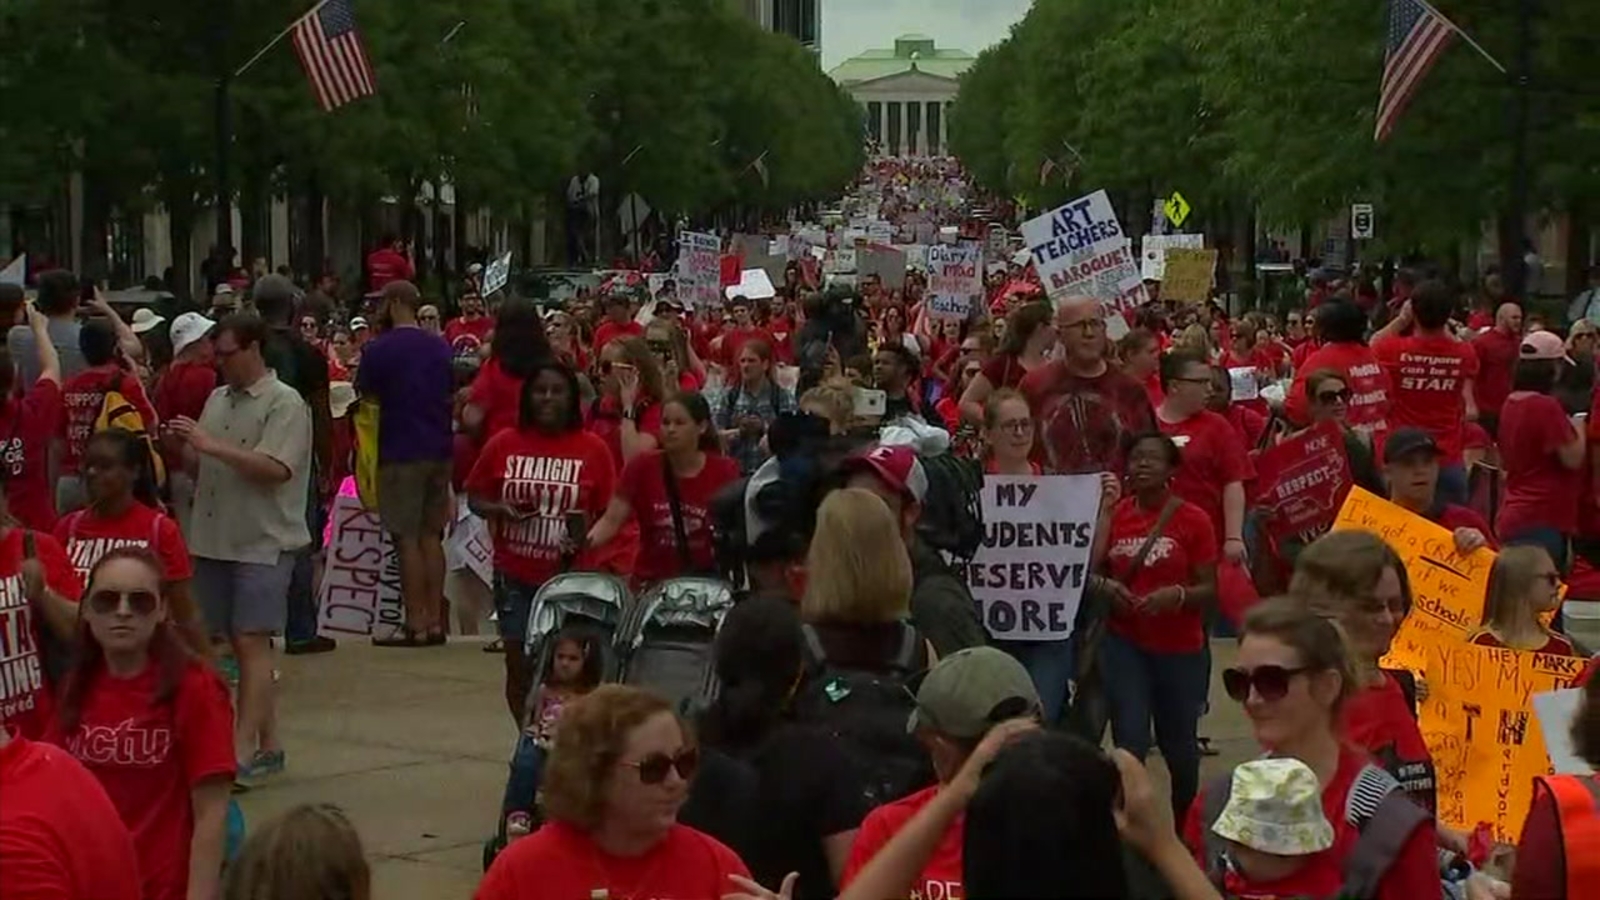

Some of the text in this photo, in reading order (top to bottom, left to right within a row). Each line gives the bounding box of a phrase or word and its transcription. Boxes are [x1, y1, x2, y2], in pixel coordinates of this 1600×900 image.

[1052, 199, 1094, 238] ART
[1031, 219, 1119, 264] TEACHERS
[1050, 246, 1131, 288] BAROQUE!
[1400, 352, 1462, 365] Everyone
[1400, 366, 1425, 375] can
[1430, 366, 1447, 376] be
[1400, 377, 1456, 391] STAR
[504, 454, 584, 483] STRAIGHT
[1276, 466, 1330, 498] RESPECT
[996, 483, 1038, 507] MY
[981, 522, 1091, 548] UDENTS
[322, 505, 382, 636] RESPECT
[1423, 537, 1483, 577] CRAZY
[1488, 648, 1523, 665] HEY
[1531, 653, 1577, 674] MARK
